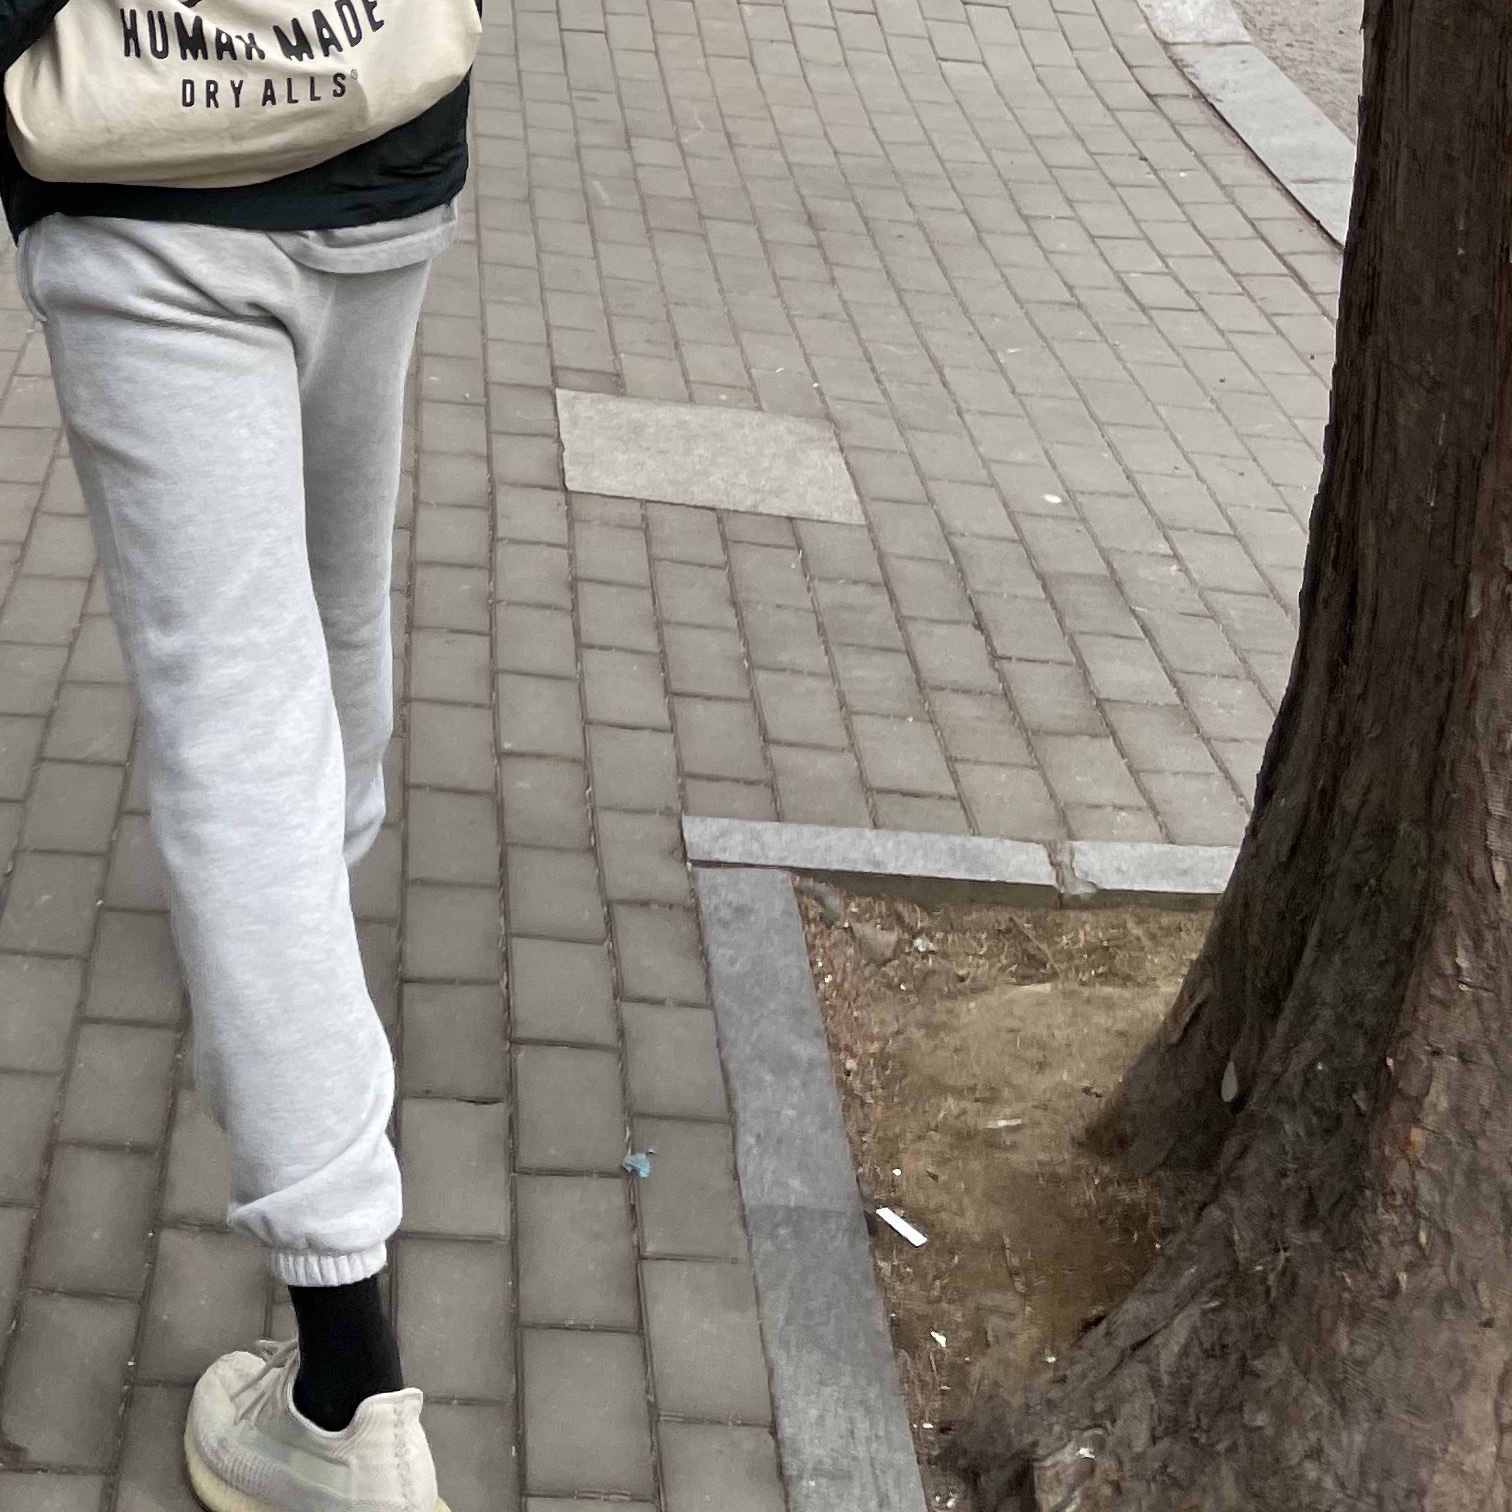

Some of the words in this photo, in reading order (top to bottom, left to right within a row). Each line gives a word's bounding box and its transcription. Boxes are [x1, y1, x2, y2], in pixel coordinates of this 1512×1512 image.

[119, 7, 266, 61] HUMAN
[181, 78, 244, 108] DRY
[261, 72, 347, 107] ALLS
